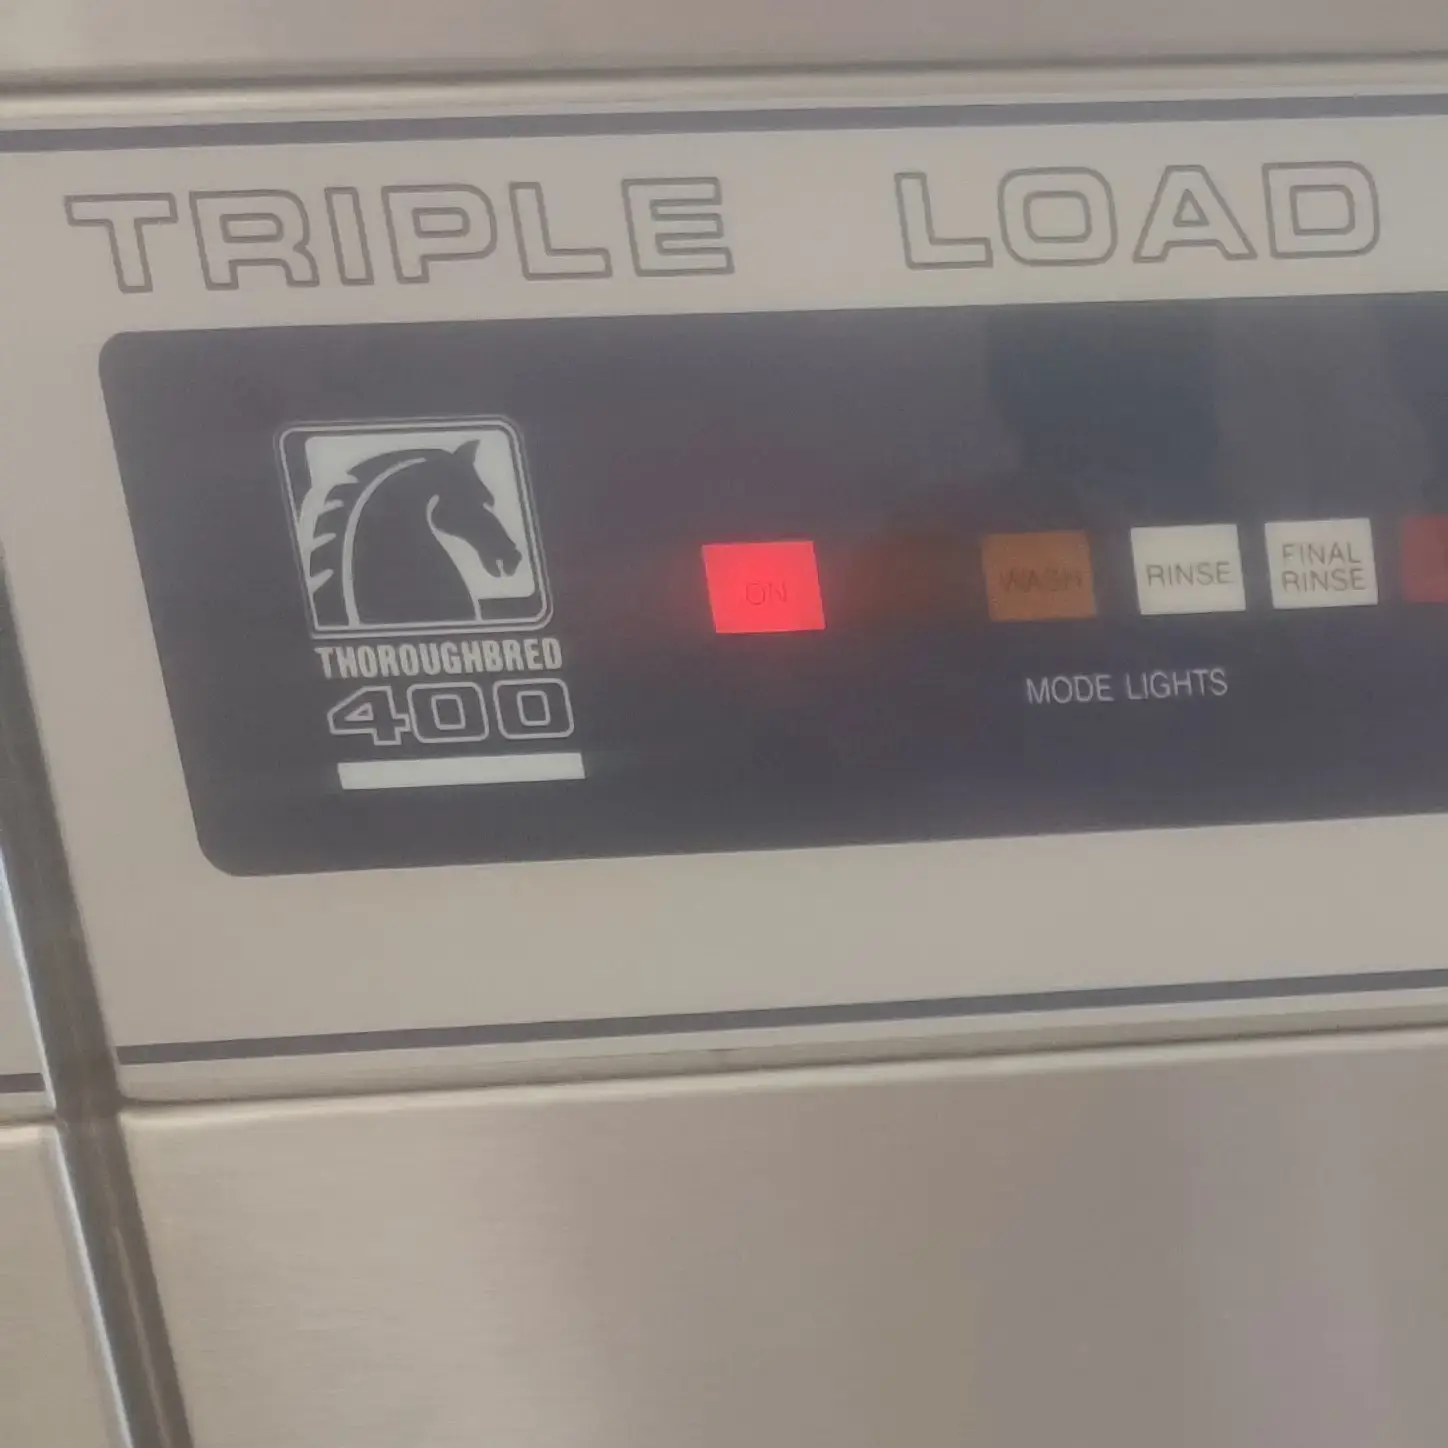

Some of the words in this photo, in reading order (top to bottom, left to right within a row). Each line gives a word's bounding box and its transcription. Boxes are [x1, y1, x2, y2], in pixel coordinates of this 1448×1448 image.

[64, 177, 734, 293] TRIPLE
[895, 161, 1380, 269] LOAD
[1281, 541, 1363, 566] FINAL
[1146, 559, 1233, 588] RINSE
[1281, 566, 1367, 593] RINSE
[744, 580, 788, 607] ON
[315, 639, 563, 678] THOROUGHBRED
[1024, 674, 1114, 706] MODE
[1124, 668, 1229, 702] LIGHTS
[328, 678, 575, 746] 400
